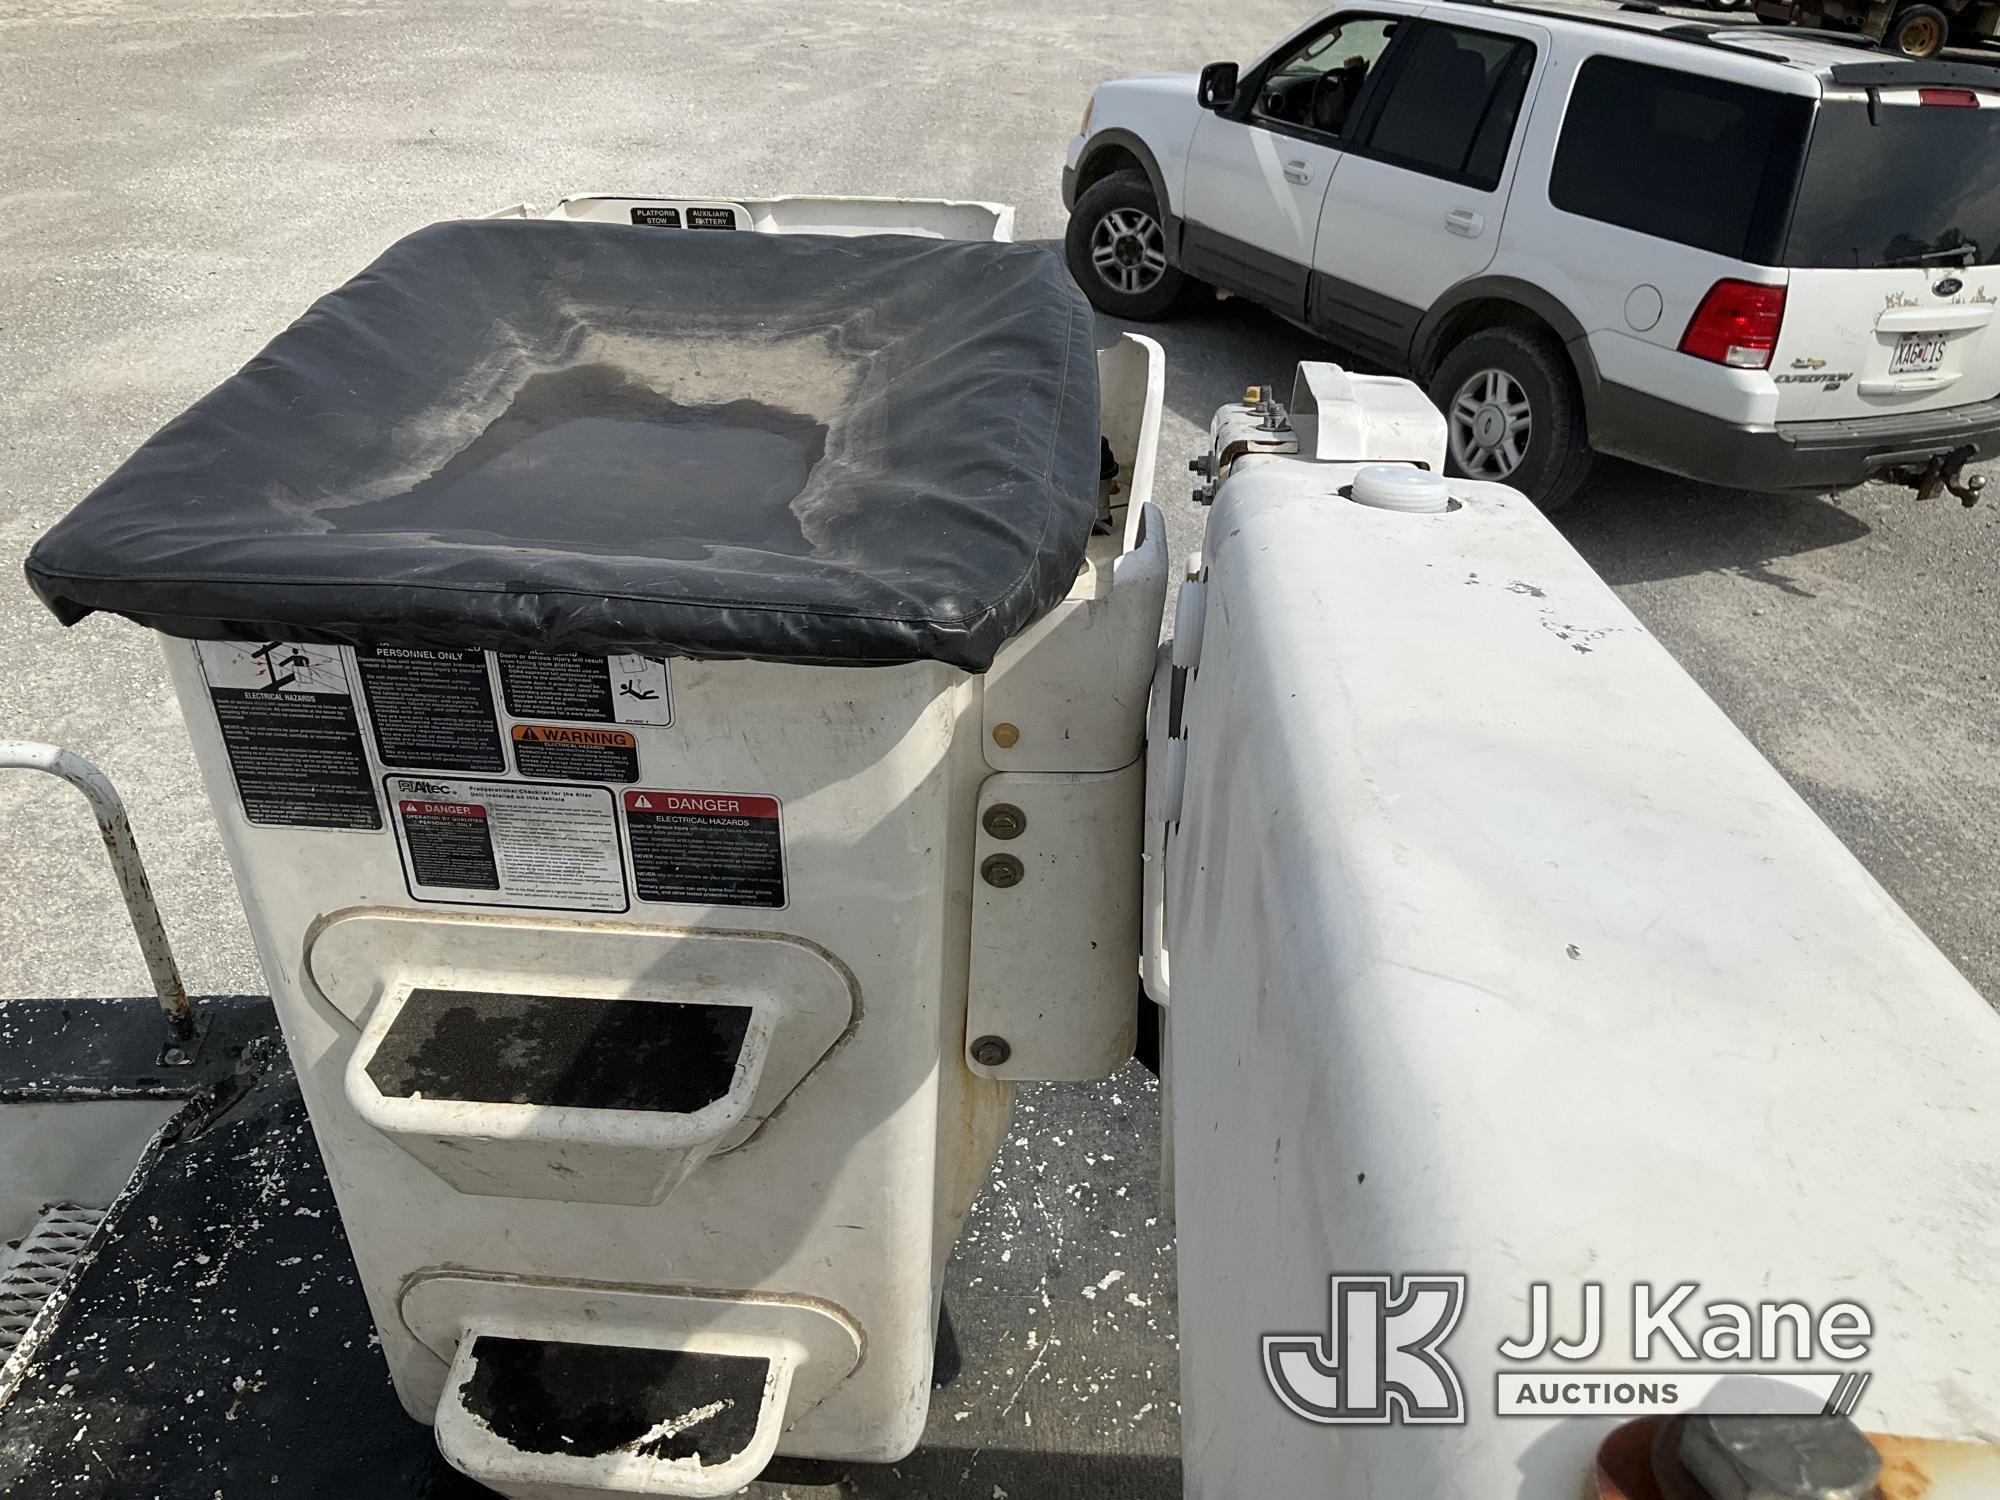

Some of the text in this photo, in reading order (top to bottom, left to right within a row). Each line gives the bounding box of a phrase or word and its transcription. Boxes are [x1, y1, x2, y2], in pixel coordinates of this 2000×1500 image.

[376, 648, 462, 660] PERSONNEL ONLY
[244, 692, 316, 702] ELECTRICAL HAZARDS
[542, 729, 626, 745] WARNING
[424, 804, 471, 814] DANGER
[668, 798, 740, 812] DANGER
[656, 816, 750, 826] ELECTRICAL HAZARDS
